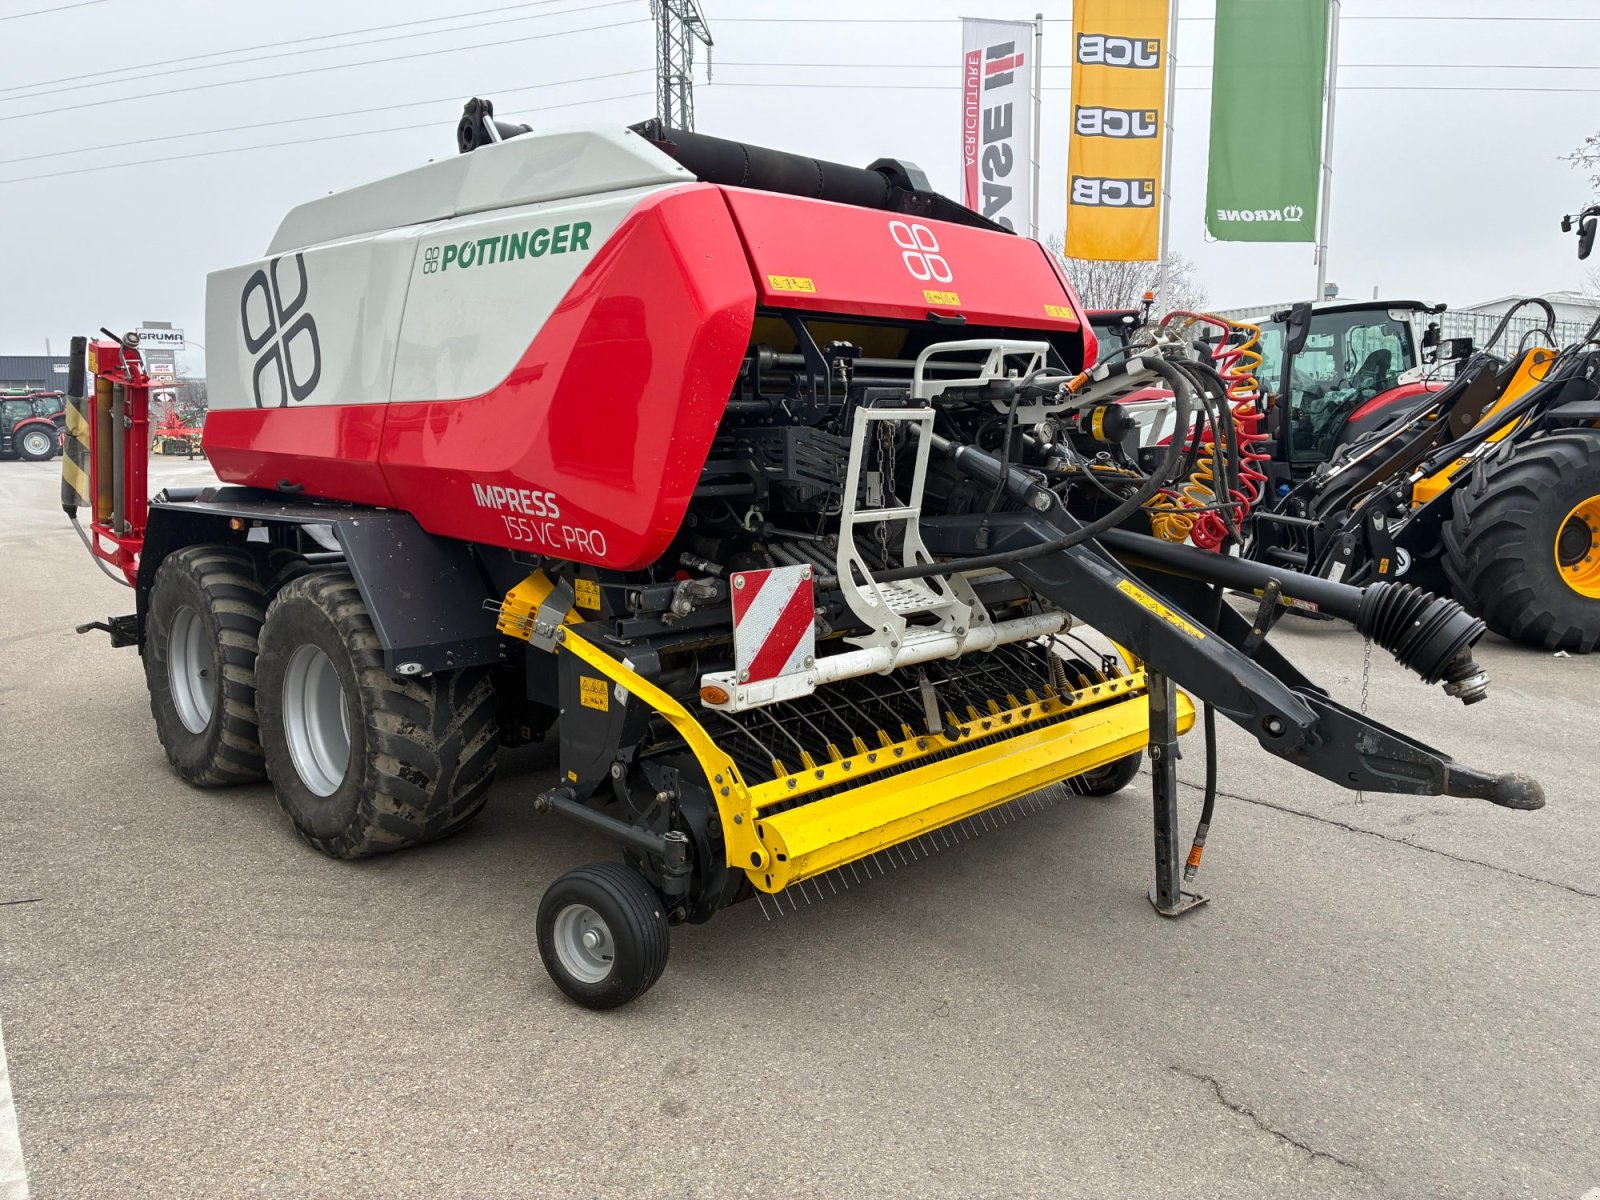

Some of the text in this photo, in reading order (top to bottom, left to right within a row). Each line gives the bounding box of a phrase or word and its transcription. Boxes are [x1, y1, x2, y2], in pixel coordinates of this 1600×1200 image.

[441, 221, 592, 272] PÖTTINGER
[139, 332, 183, 341] GRUMA
[471, 482, 560, 519] IMPRESS
[501, 514, 607, 557] 155 VC PRO
